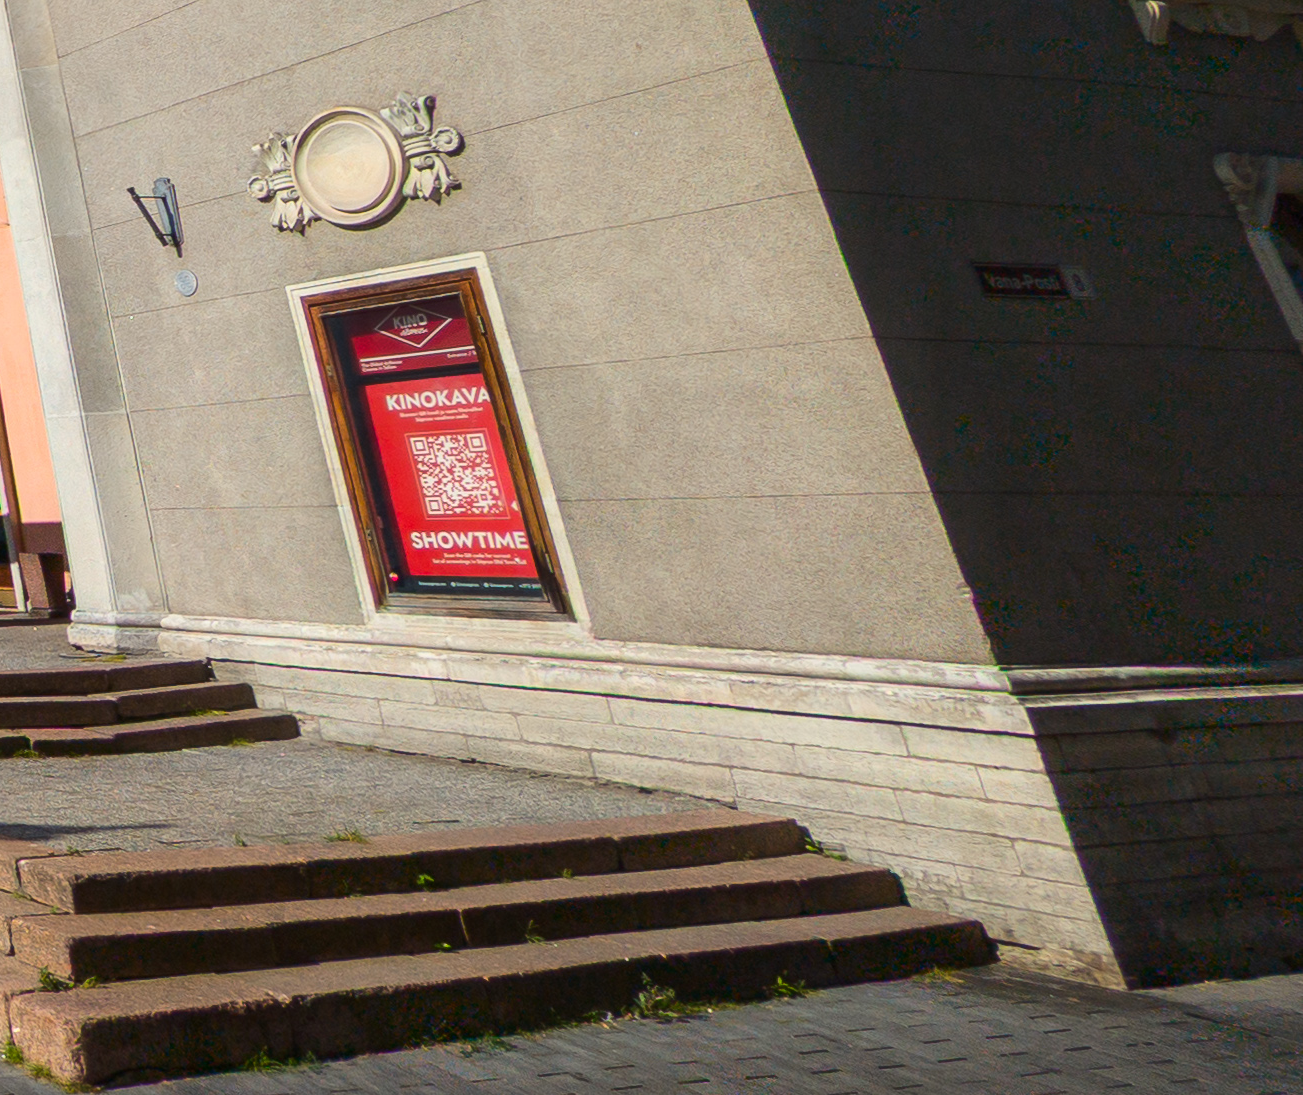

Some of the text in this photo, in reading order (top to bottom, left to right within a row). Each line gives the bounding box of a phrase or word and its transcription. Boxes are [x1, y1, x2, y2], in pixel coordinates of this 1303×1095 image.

[392, 313, 428, 329] KINO
[385, 386, 491, 411] KINOKAVA
[410, 531, 529, 550] SHOWTIME
